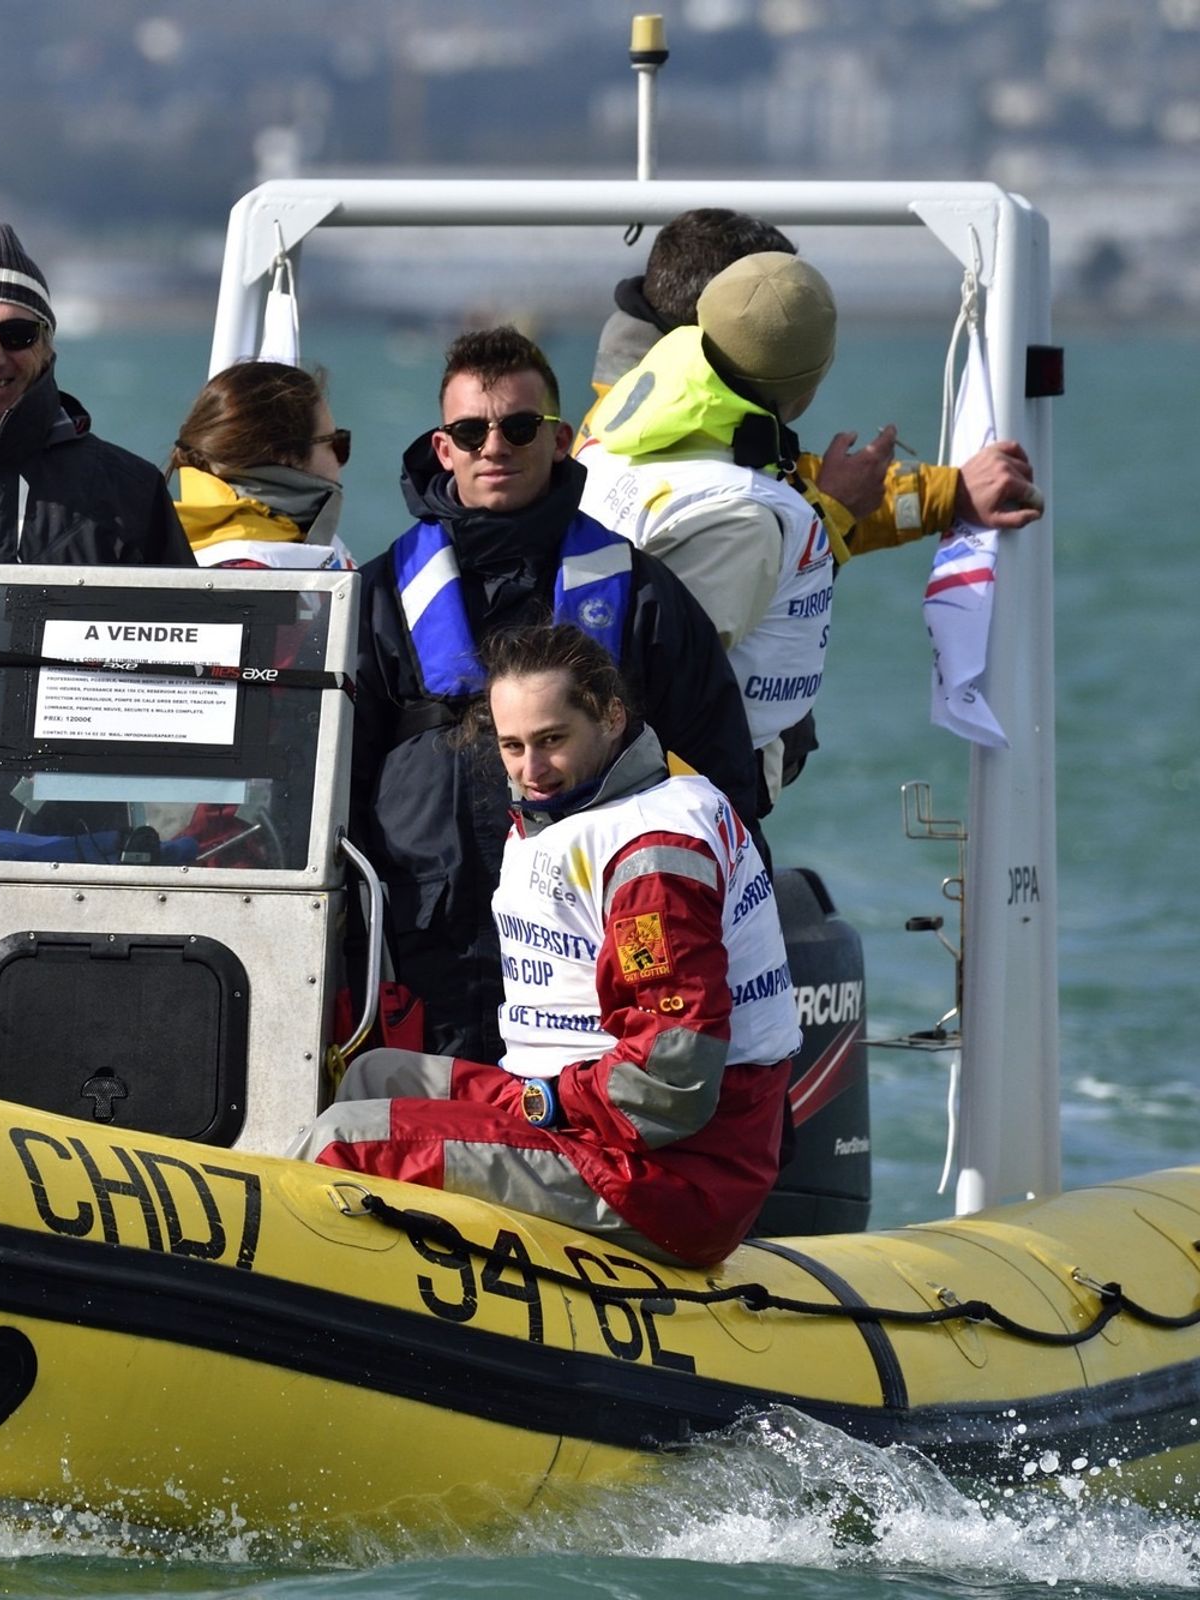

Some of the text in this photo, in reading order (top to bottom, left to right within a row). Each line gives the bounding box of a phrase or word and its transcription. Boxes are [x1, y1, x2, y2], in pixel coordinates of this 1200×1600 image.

[84, 625, 199, 643] A VENDRE
[242, 667, 279, 682] axe
[528, 871, 577, 907] Pelée
[498, 912, 598, 961] UNIVERSITY
[521, 958, 554, 987] CUP
[9, 1127, 261, 1271] CHD7
